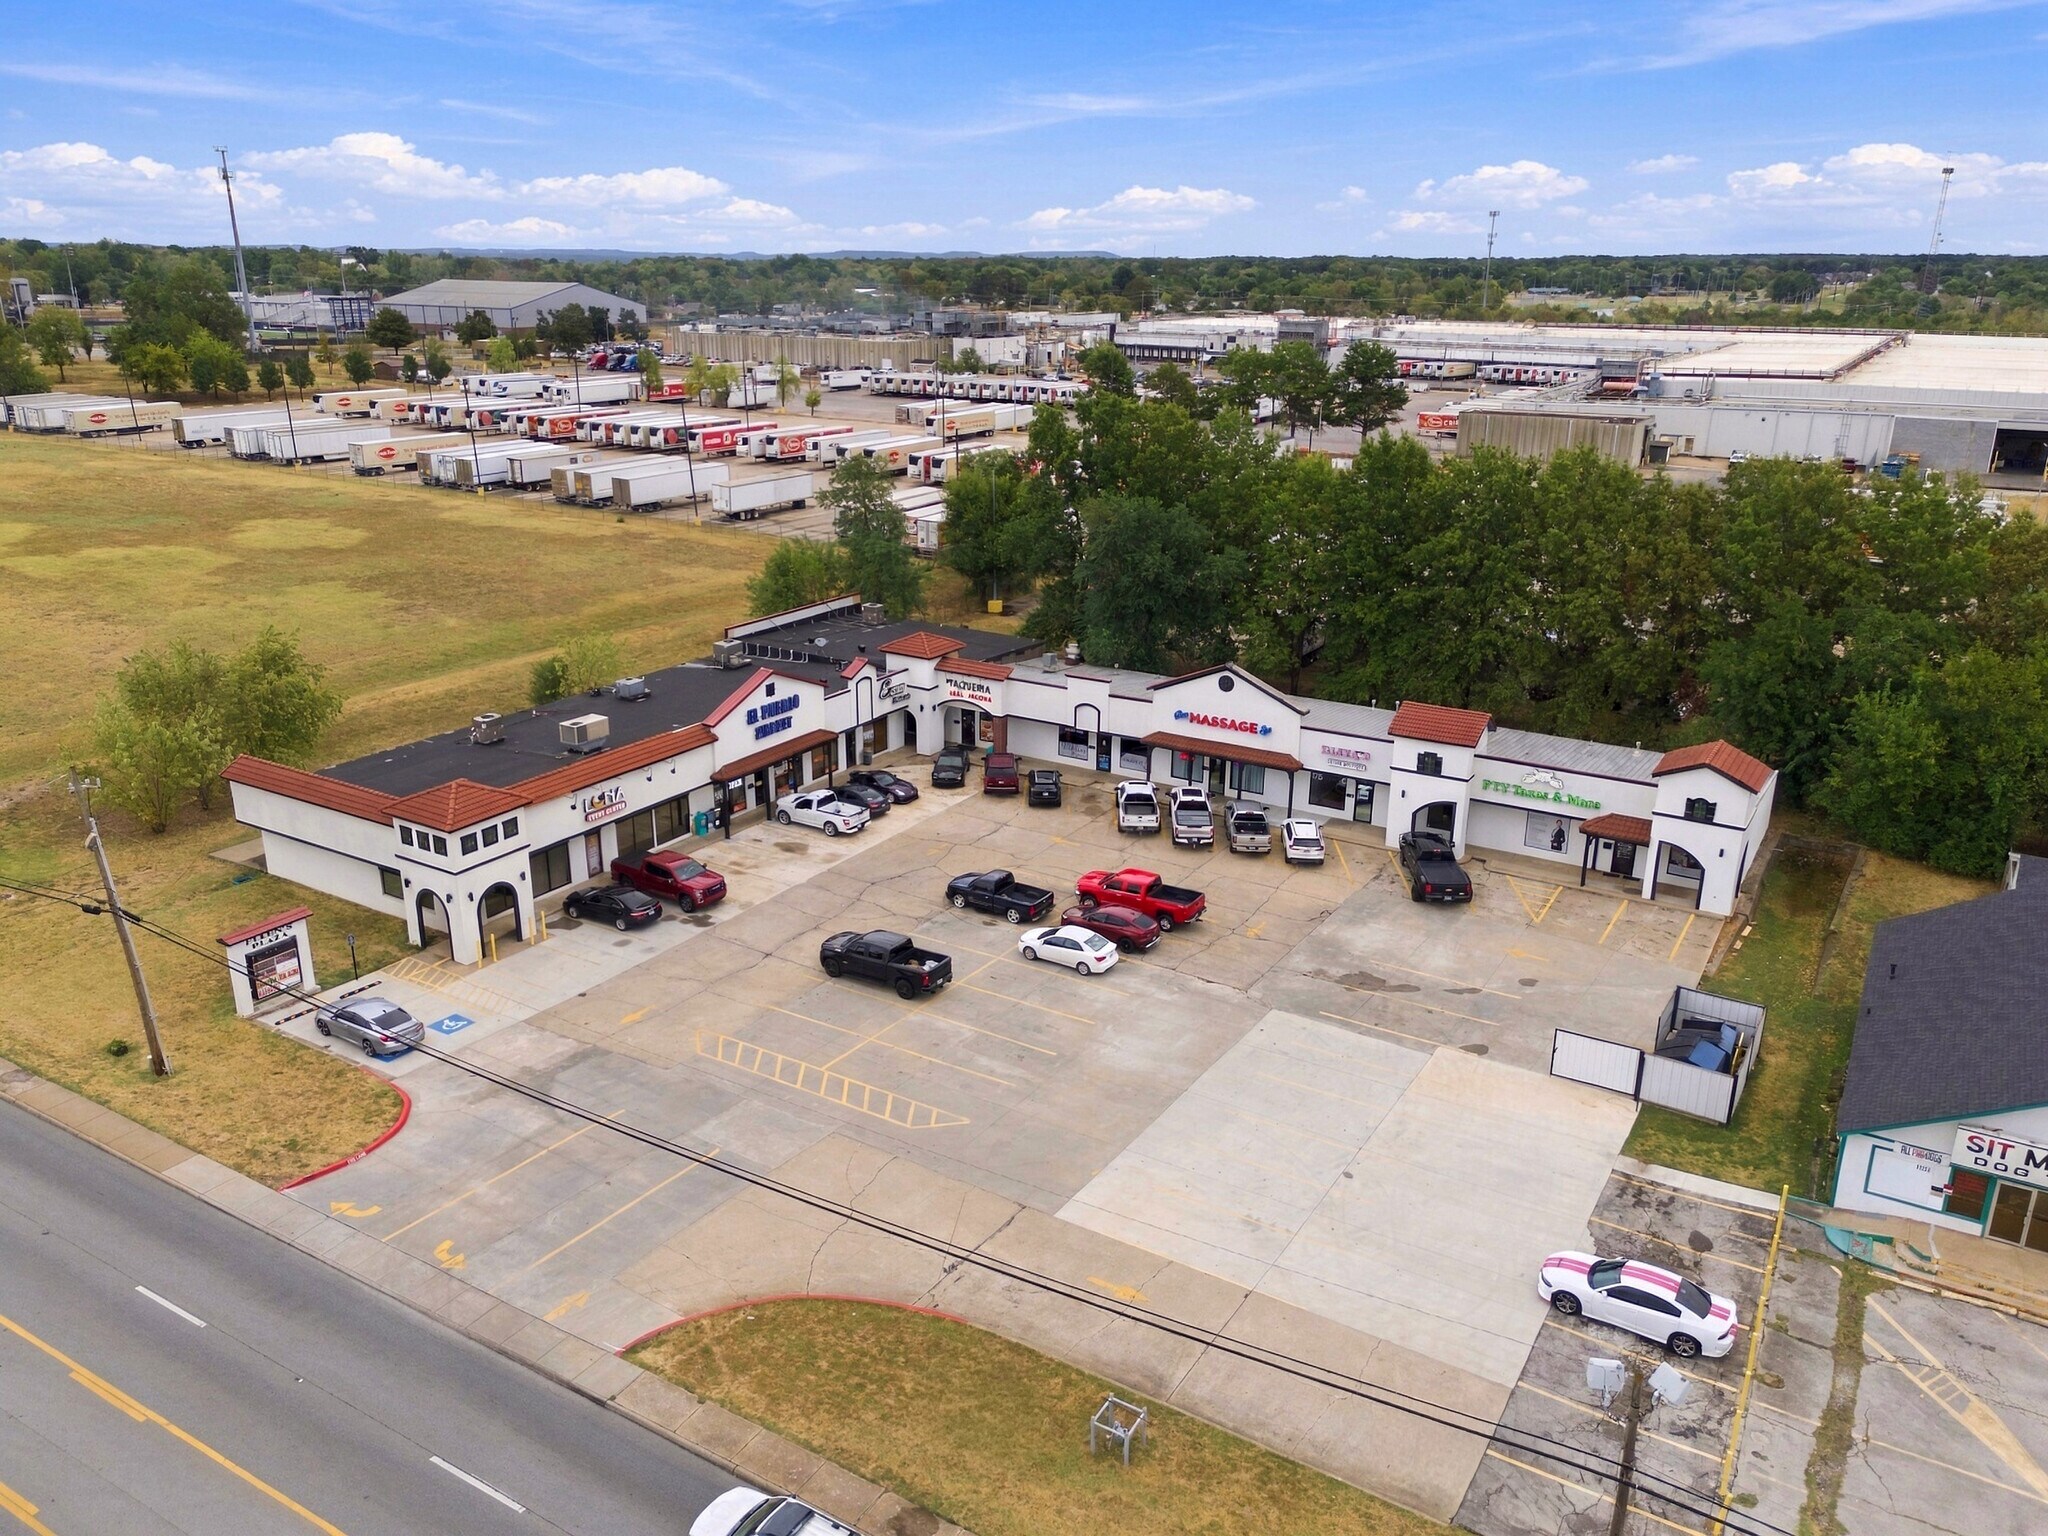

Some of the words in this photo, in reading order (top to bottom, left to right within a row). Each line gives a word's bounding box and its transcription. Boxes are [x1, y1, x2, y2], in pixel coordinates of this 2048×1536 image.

[945, 678, 992, 694] TAQUERIA
[760, 694, 800, 720] PUEBLO
[1189, 712, 1259, 734] MASSAGE
[1552, 791, 1563, 802] &
[1966, 1135, 2016, 1160] SIT
[1974, 1156, 2030, 1177] DOG
